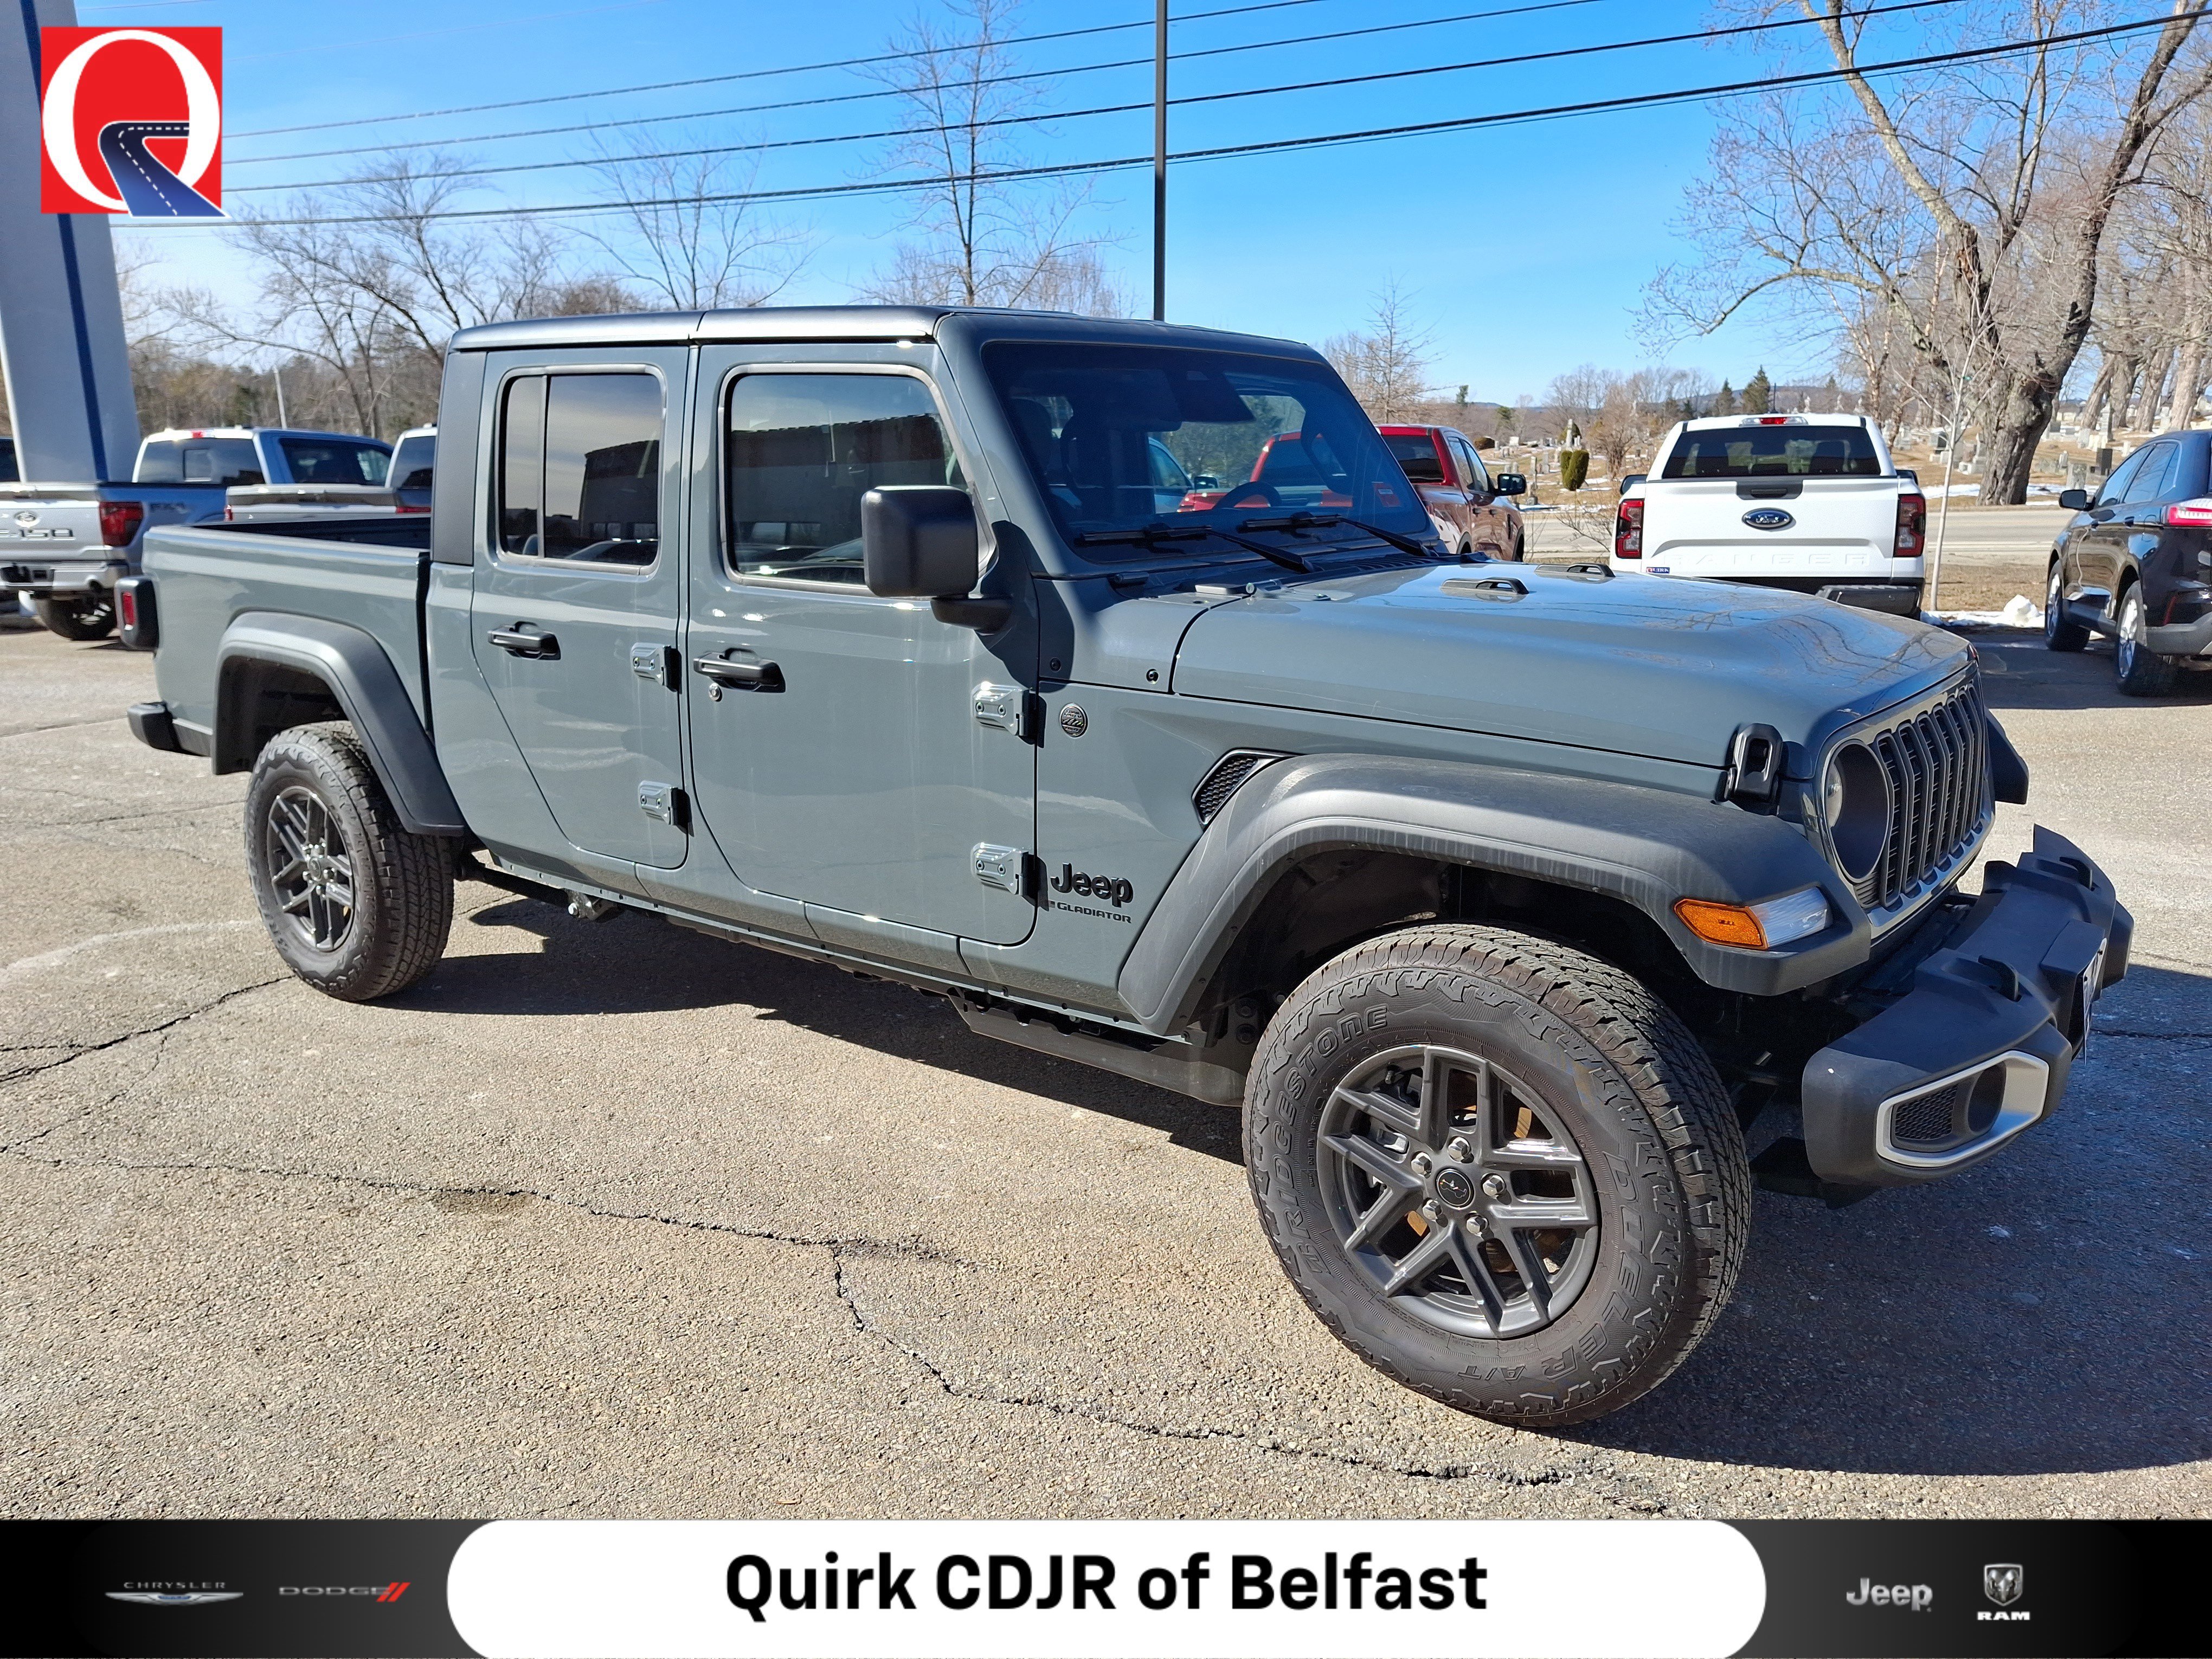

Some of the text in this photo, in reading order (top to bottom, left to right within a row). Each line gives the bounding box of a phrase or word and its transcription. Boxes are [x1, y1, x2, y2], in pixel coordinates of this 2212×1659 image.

[1050, 863, 1134, 908] Jeep
[1057, 902, 1132, 924] GLADIATOR
[1272, 1003, 1389, 1275] BRIDGESTONE
[1542, 1151, 1645, 1381] DUELER
[1457, 1363, 1527, 1381] A/T
